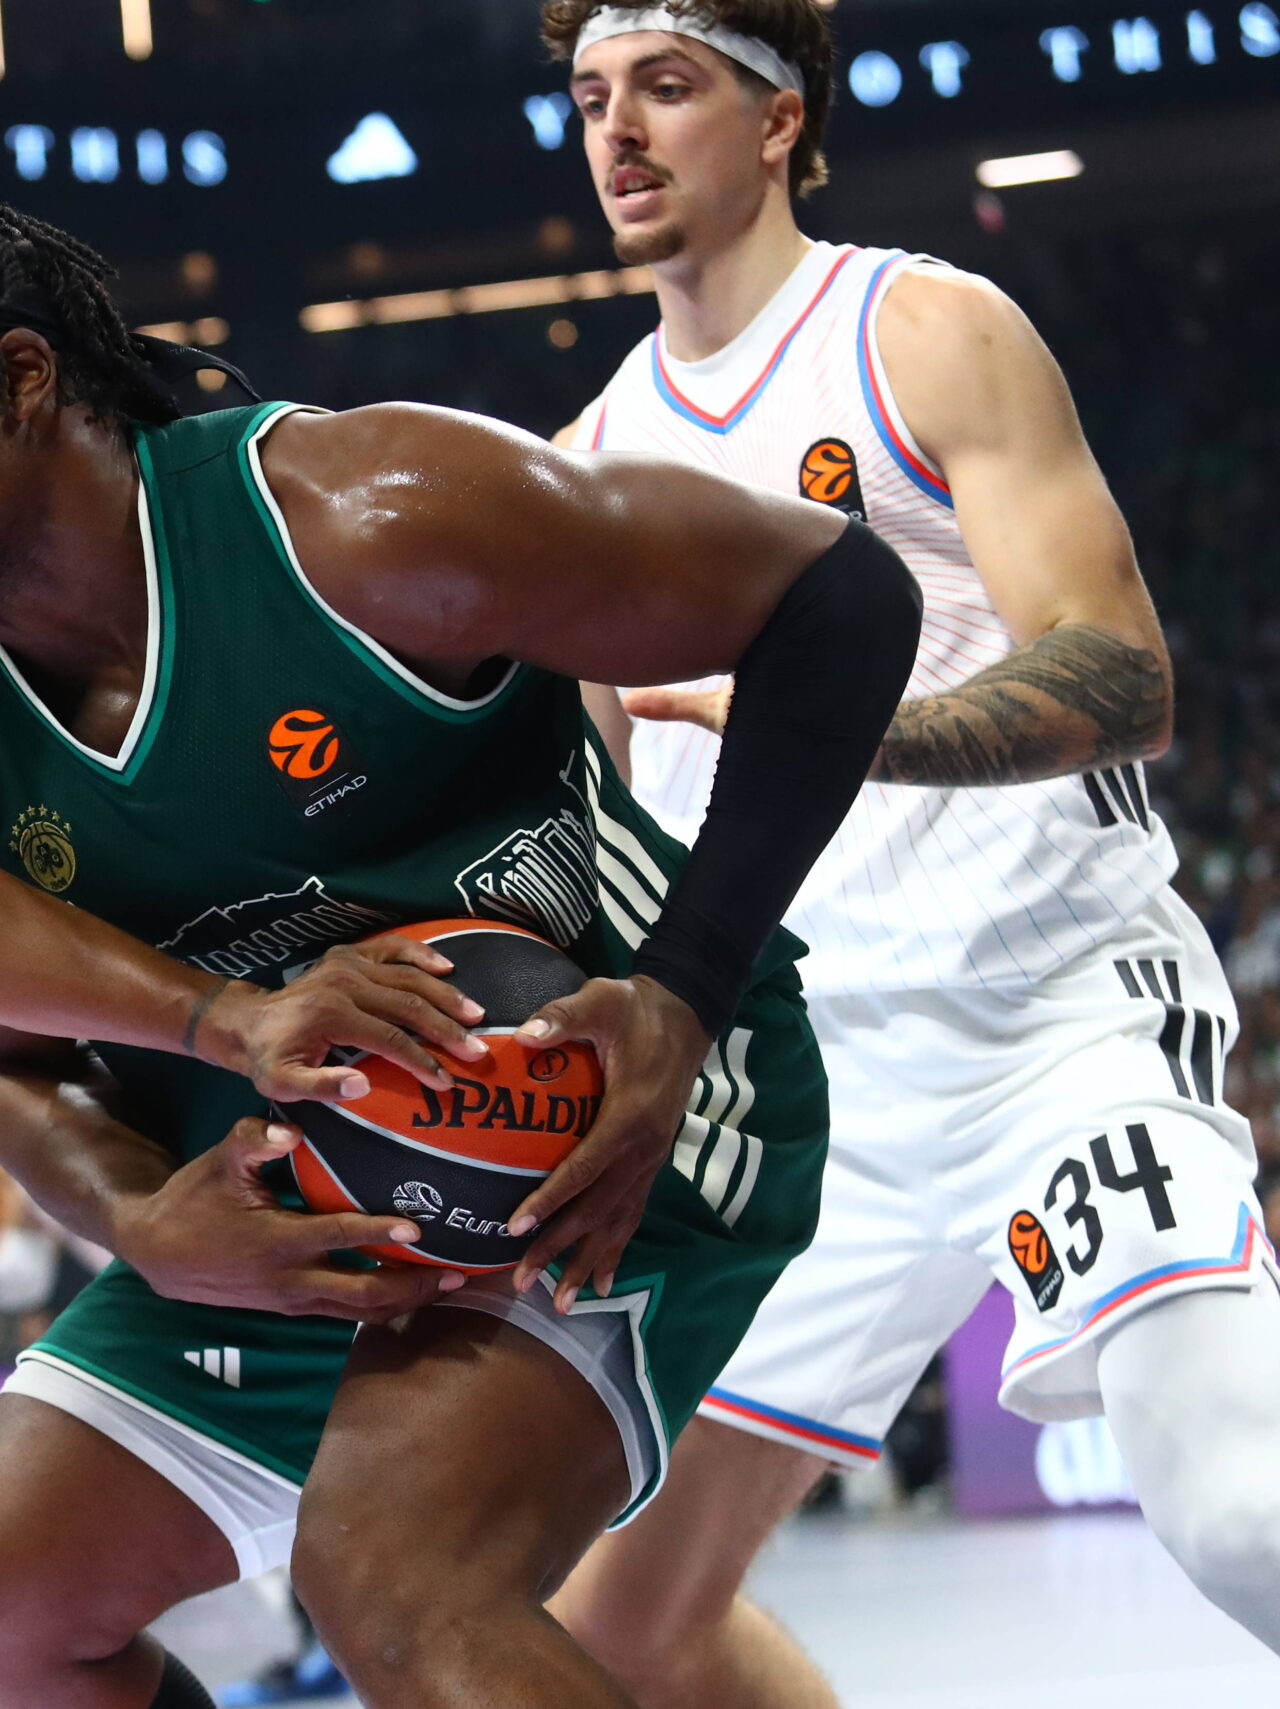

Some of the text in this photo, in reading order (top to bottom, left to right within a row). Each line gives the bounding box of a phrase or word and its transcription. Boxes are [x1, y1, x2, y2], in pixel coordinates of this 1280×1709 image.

[848, 1, 1280, 107] OT THIS
[4, 123, 227, 186] THIS
[304, 775, 367, 817] ETIHAD
[445, 1206, 513, 1237] Euro
[1043, 1122, 1177, 1277] 34
